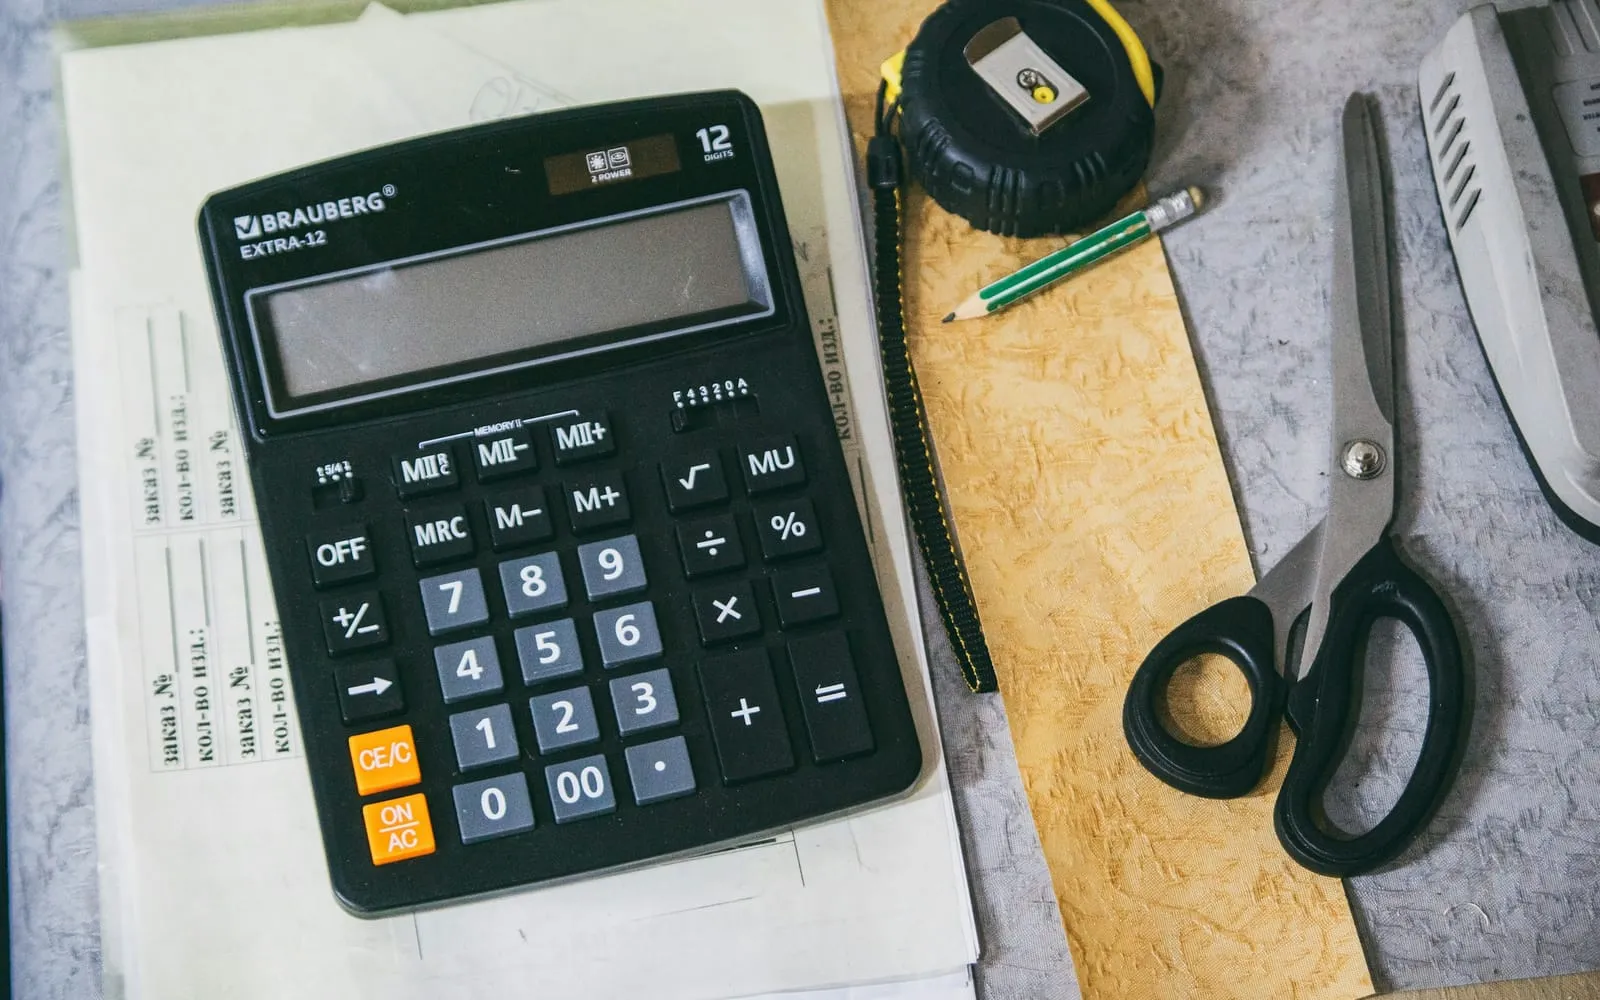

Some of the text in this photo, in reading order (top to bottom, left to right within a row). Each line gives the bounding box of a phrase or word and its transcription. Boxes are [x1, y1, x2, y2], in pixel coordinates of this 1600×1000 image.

[696, 124, 732, 153] 12
[704, 149, 734, 162] DIGITS
[591, 168, 632, 183] 2 POWER
[240, 230, 327, 260] EXTRA-12
[474, 420, 514, 436] MEMORY
[748, 446, 795, 476] MU
[142, 467, 161, 524] заказ
[175, 449, 194, 521] кол-во
[217, 460, 235, 517] заказ
[573, 486, 620, 513] M+
[414, 516, 467, 546] MRC
[316, 536, 366, 566] OFF
[598, 548, 624, 580] 9
[519, 565, 547, 597] 8
[438, 581, 464, 614] 7
[615, 614, 641, 647] 6
[535, 631, 561, 665] 5
[456, 649, 484, 680] 4
[190, 628, 213, 762] кол-во изд.:
[631, 682, 657, 715] 3
[153, 674, 179, 766] заказ №
[229, 666, 256, 759] заказ №
[270, 678, 290, 754] кол-во
[551, 700, 579, 734] 2
[475, 717, 497, 749] 1
[359, 742, 412, 771] CE/C
[556, 766, 604, 804] 00
[380, 803, 413, 825] ON
[480, 787, 507, 820] 0
[388, 830, 418, 853] AC
